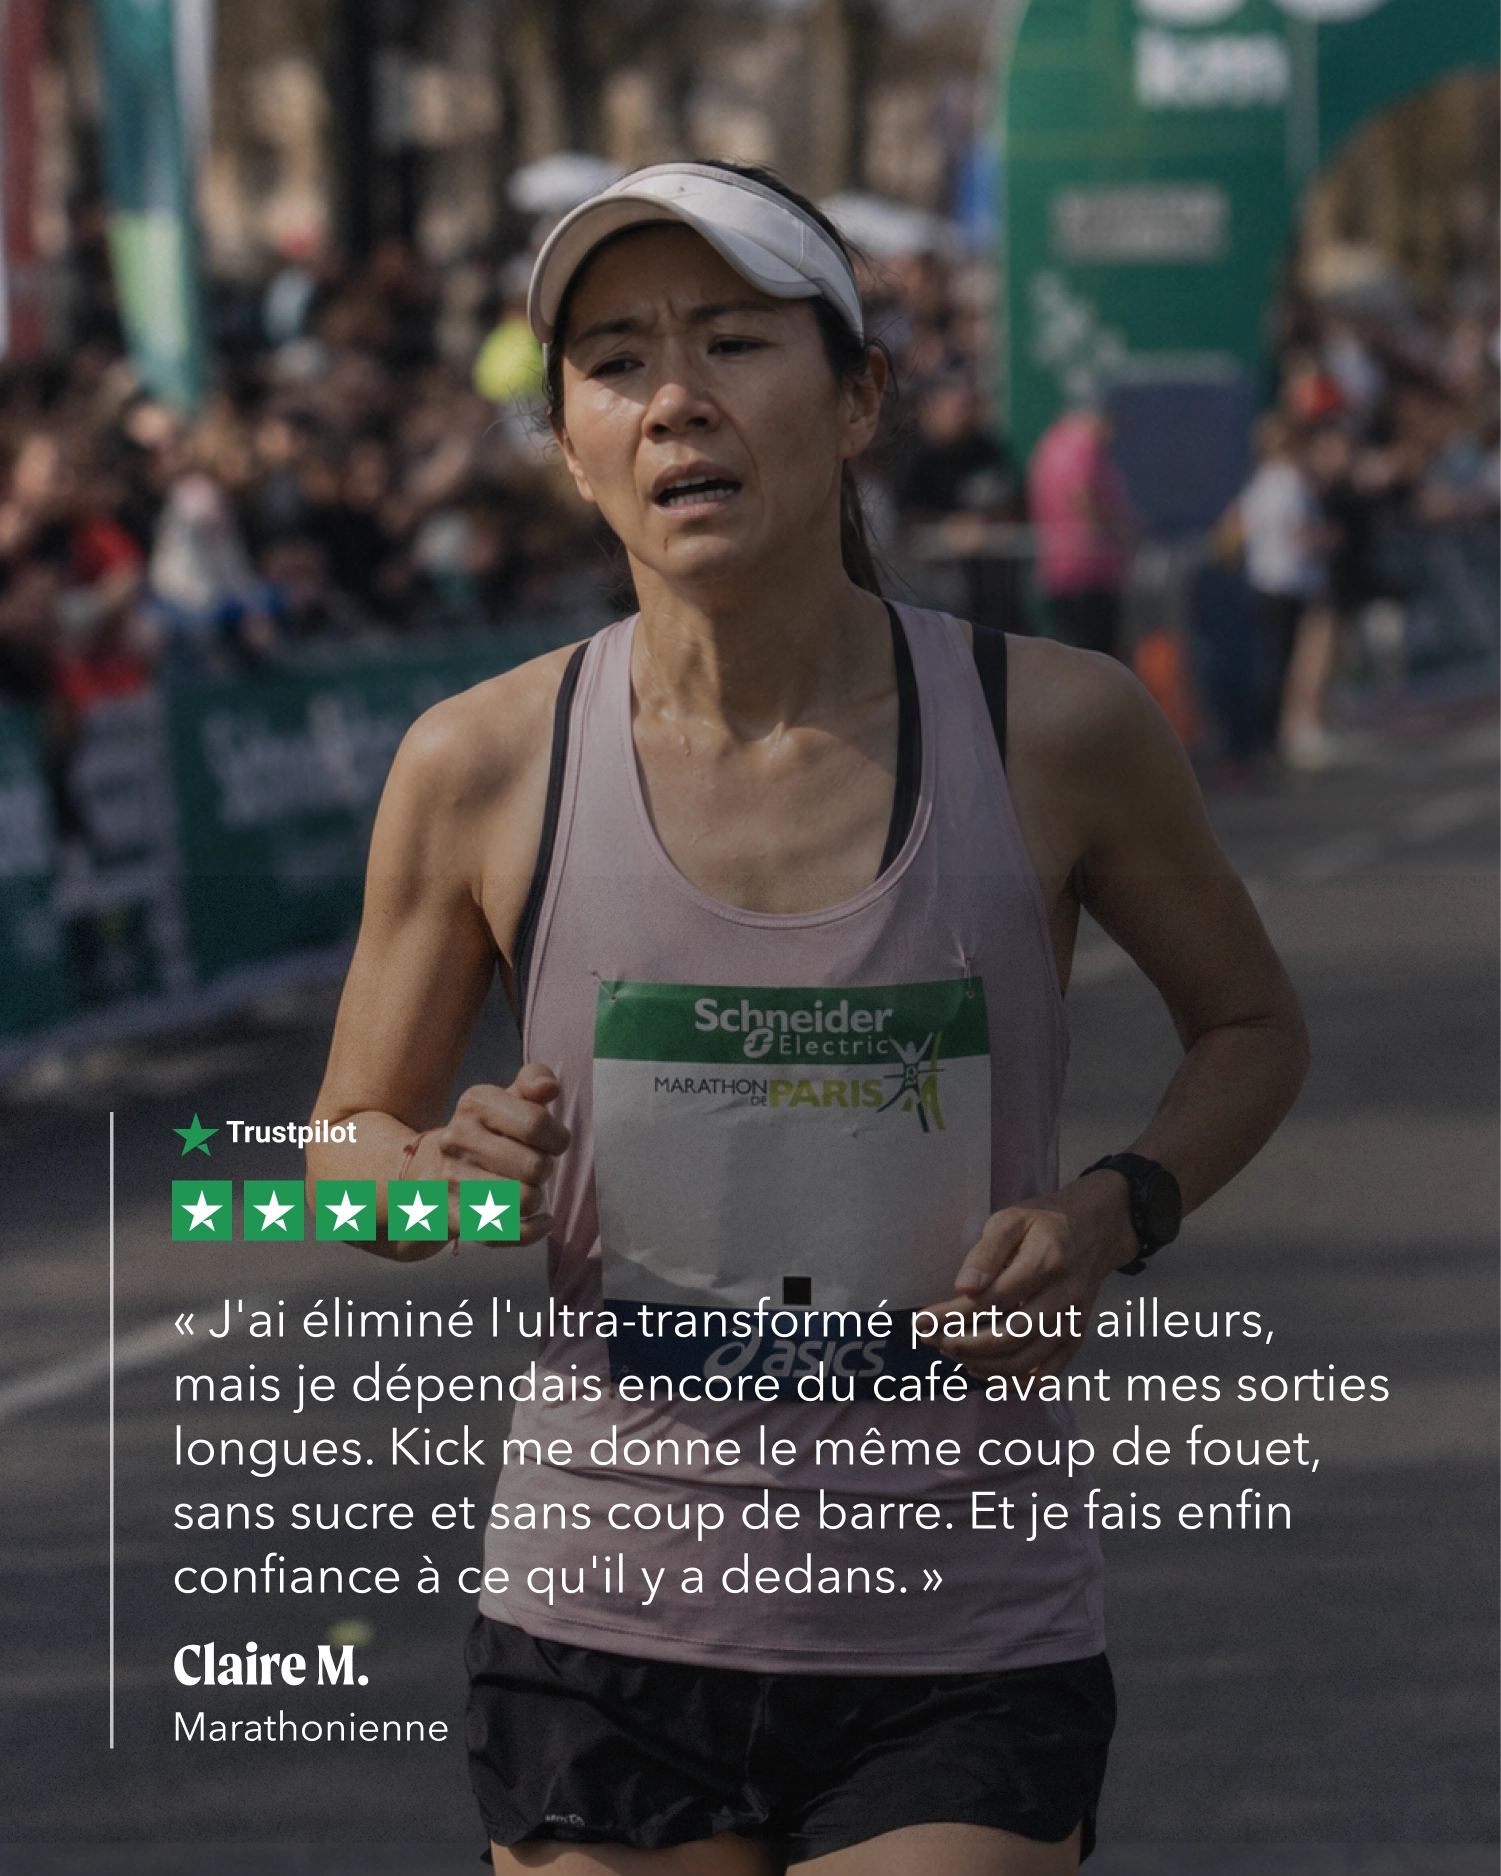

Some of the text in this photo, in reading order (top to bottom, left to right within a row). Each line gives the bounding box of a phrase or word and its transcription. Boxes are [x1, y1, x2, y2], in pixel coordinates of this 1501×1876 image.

[694, 998, 894, 1033] Schneider
[778, 1034, 889, 1056] Electric
[654, 1076, 884, 1108] MARATHON DE PARIS
